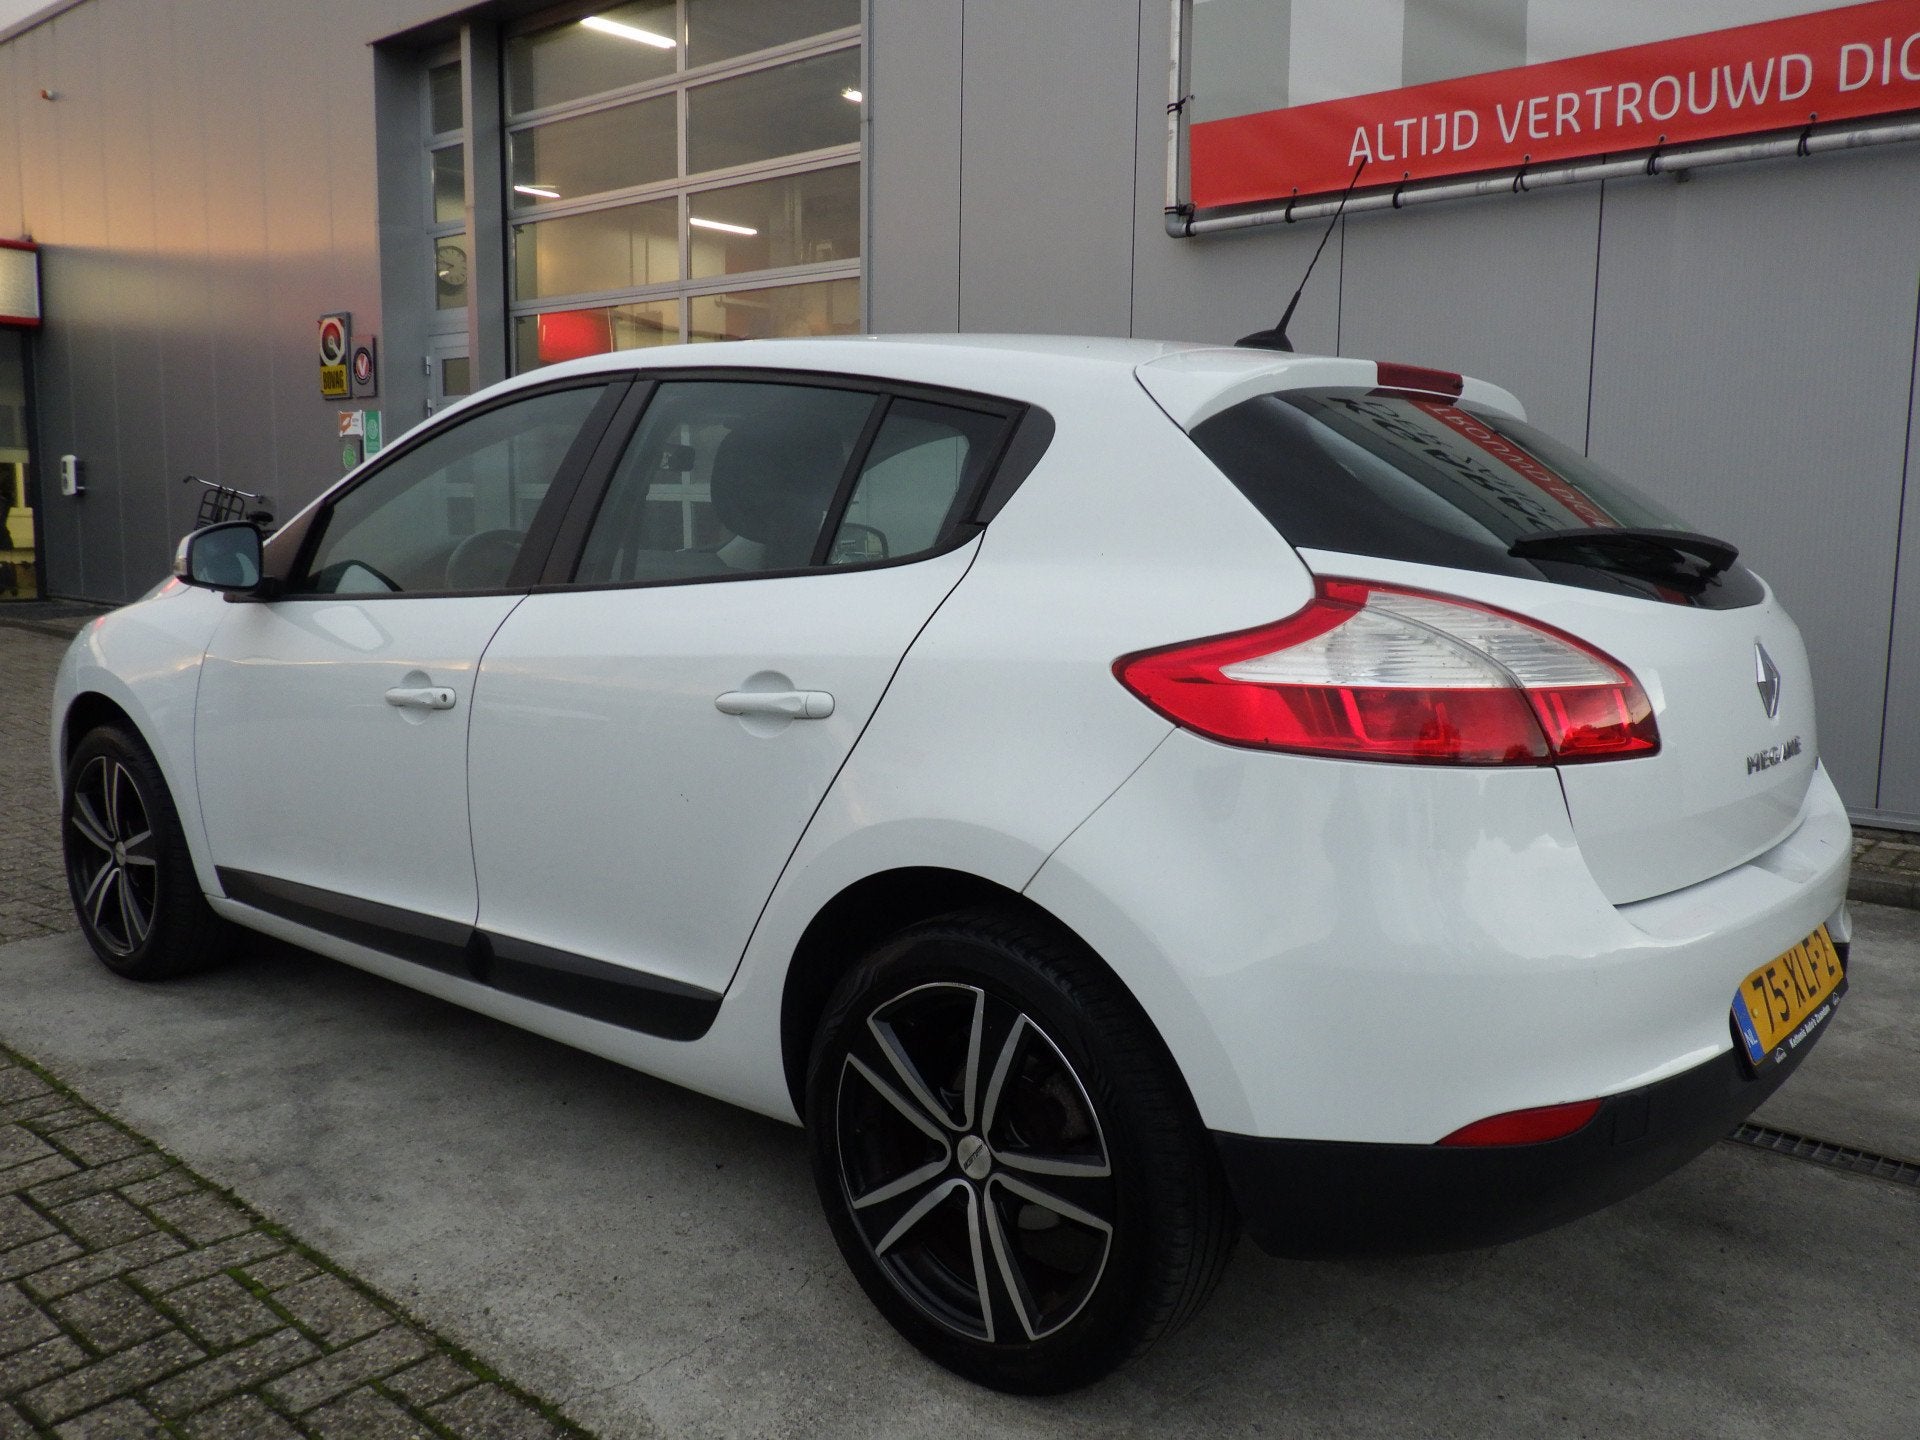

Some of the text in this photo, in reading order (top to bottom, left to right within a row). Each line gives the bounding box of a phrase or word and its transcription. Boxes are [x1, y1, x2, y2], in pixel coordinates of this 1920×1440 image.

[1348, 109, 1479, 167] ALTIJD
[1496, 53, 1813, 144] VERTROUWD
[323, 370, 344, 390] BOVAG
[1751, 929, 1835, 1034] 75-XLF-2
[1744, 1028, 1758, 1048] NL
